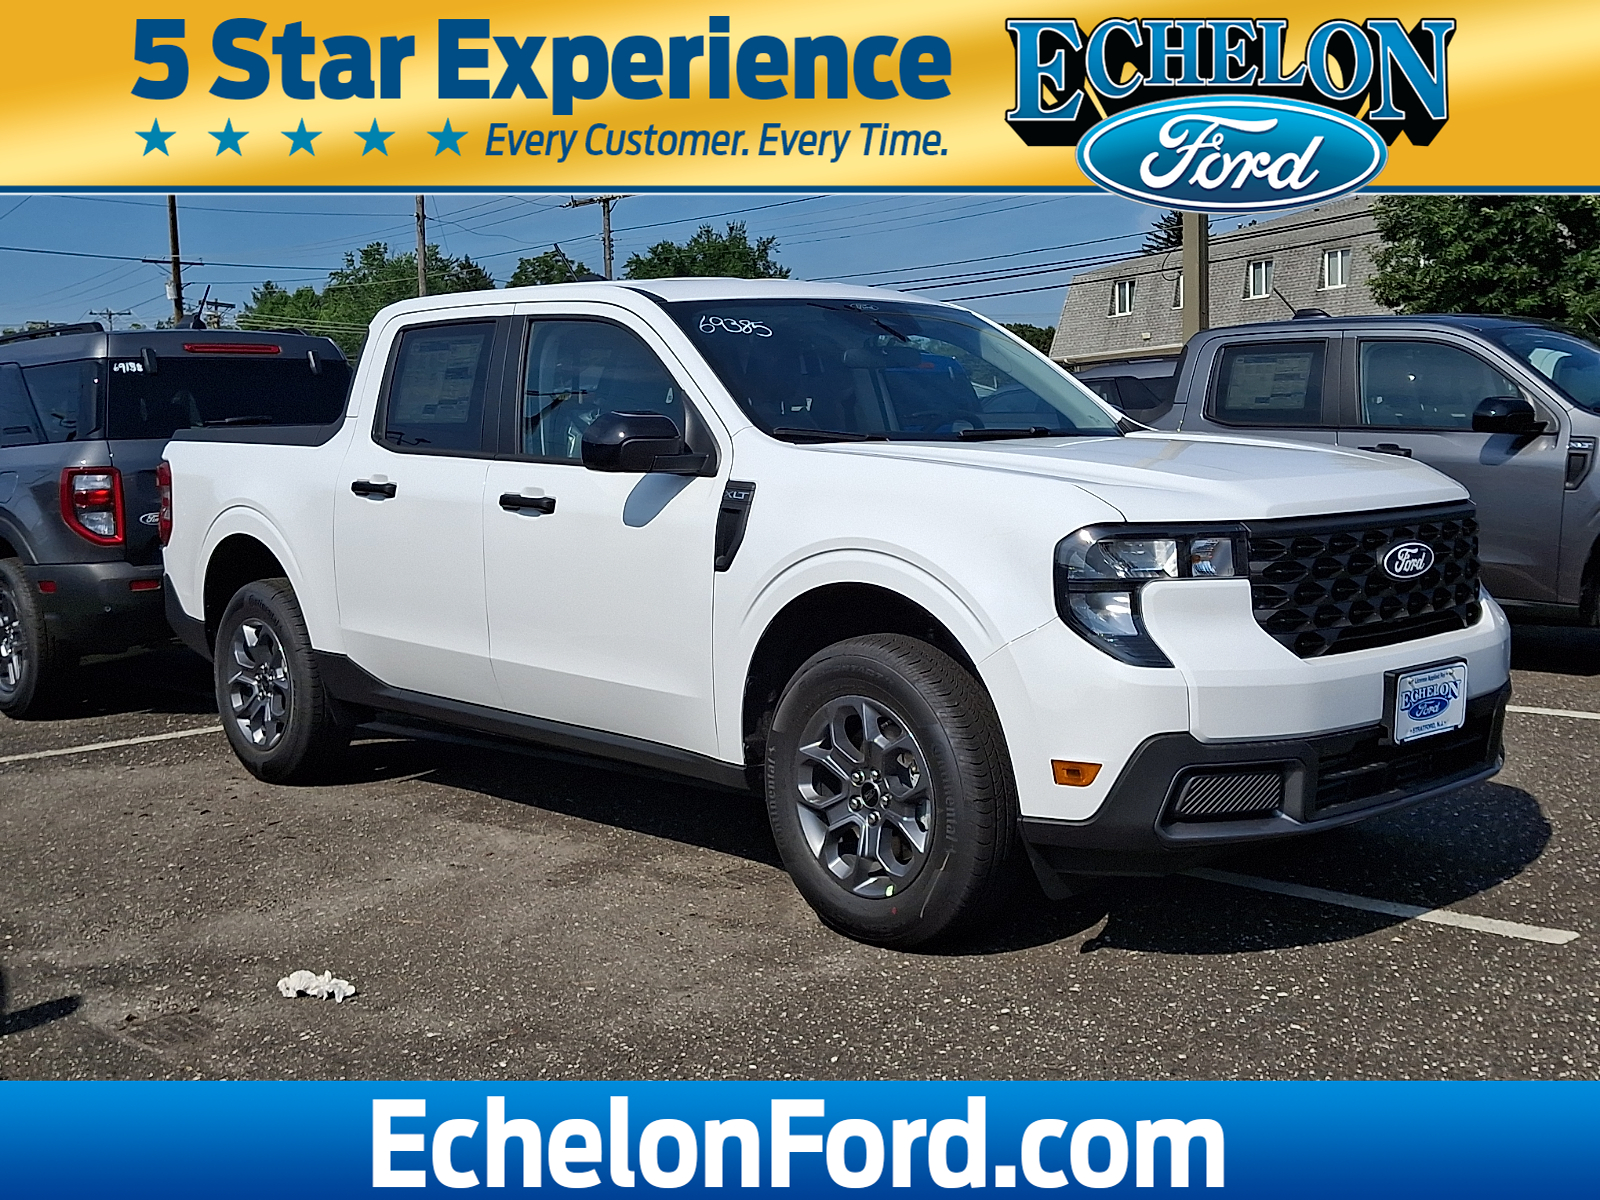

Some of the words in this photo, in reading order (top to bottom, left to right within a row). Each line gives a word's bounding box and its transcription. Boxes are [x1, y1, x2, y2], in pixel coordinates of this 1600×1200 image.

[698, 315, 773, 337] 69385
[724, 490, 749, 500] XLT
[1394, 547, 1427, 573] Ford
[1400, 679, 1461, 711] ECHELON
[1415, 700, 1441, 717] Ford
